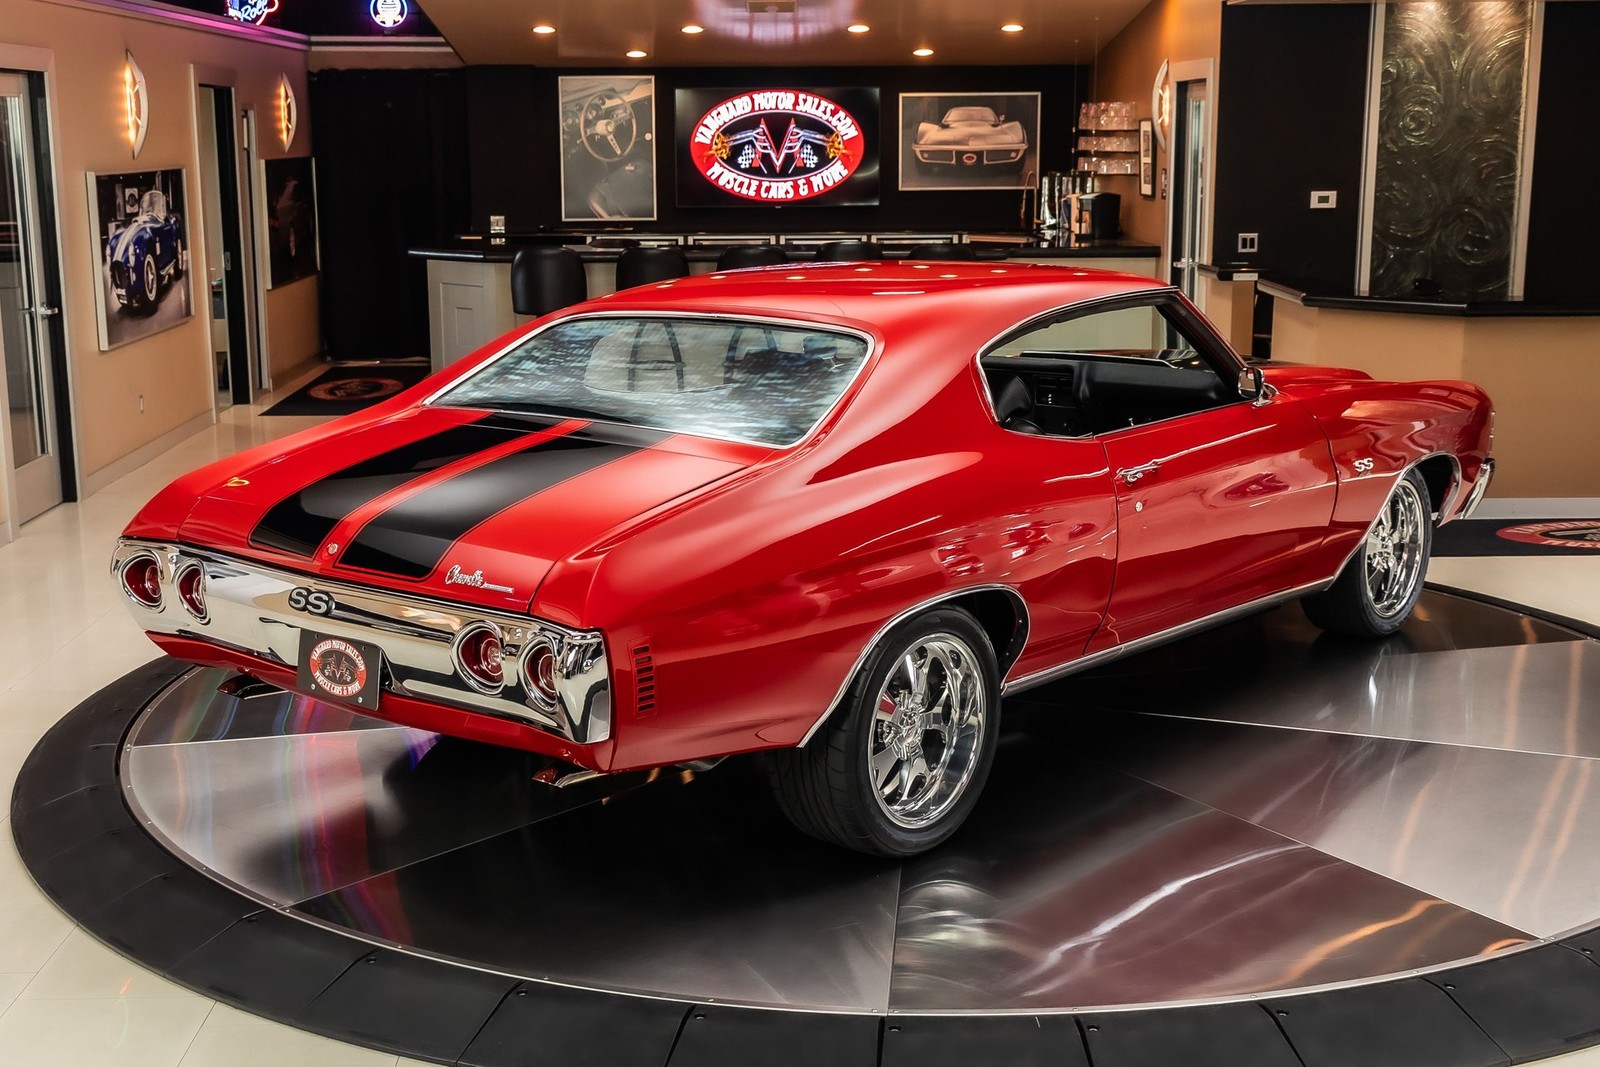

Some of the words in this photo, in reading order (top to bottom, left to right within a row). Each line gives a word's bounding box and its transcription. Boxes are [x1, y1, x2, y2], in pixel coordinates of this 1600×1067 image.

[695, 95, 752, 145] VANGUARD
[752, 91, 796, 111] MOTOR
[796, 93, 859, 141] SALES.COM
[705, 161, 760, 197] MUSCLE
[760, 180, 795, 199] CARS
[799, 178, 809, 196] &
[809, 159, 849, 193] MORE
[1353, 457, 1374, 472] SS
[289, 588, 329, 614] SS
